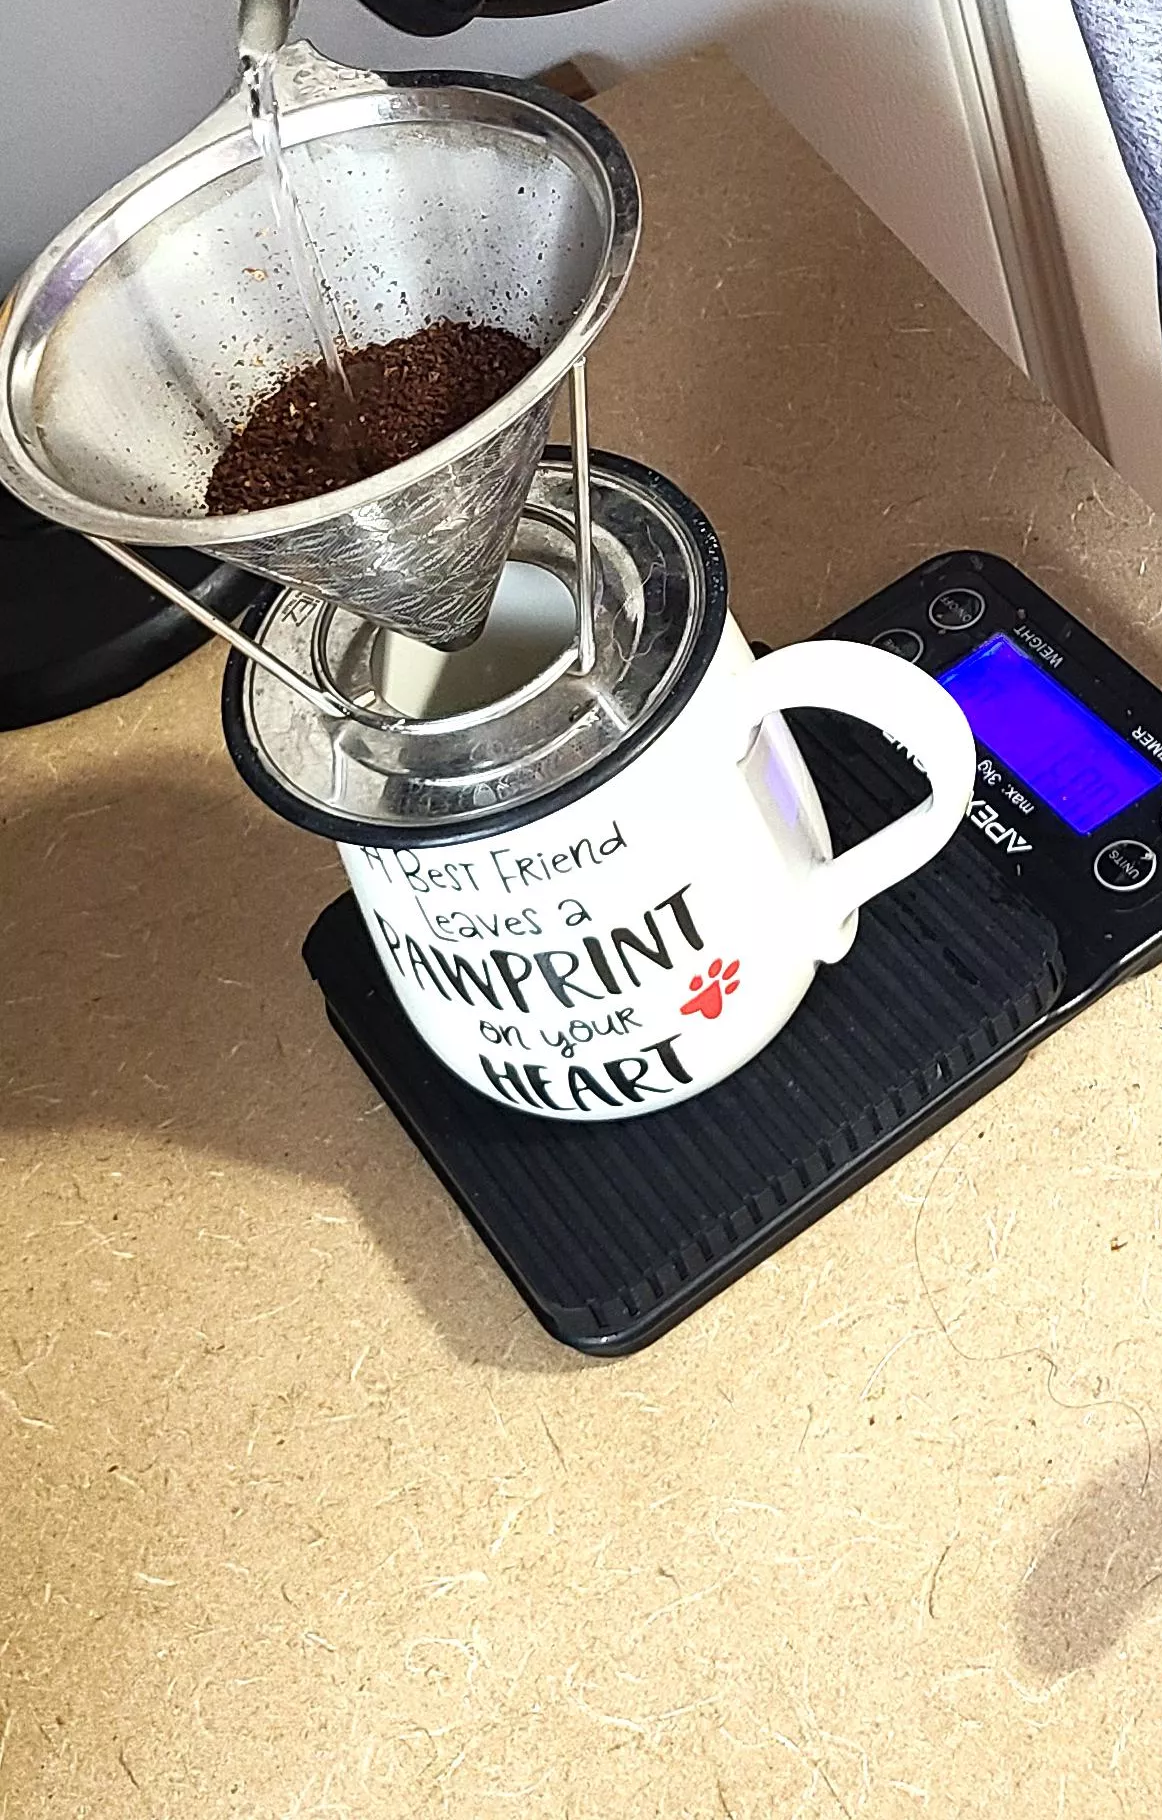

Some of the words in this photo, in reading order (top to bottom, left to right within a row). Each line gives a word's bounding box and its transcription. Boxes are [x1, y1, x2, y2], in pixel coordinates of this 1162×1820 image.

[1013, 625, 1064, 669] WEIGHT
[977, 759, 1002, 786] 3kg
[1108, 849, 1140, 880] UNITS
[557, 898, 593, 927] a
[373, 883, 705, 1014] PAWPRINT
[478, 1033, 694, 1112] HEART
